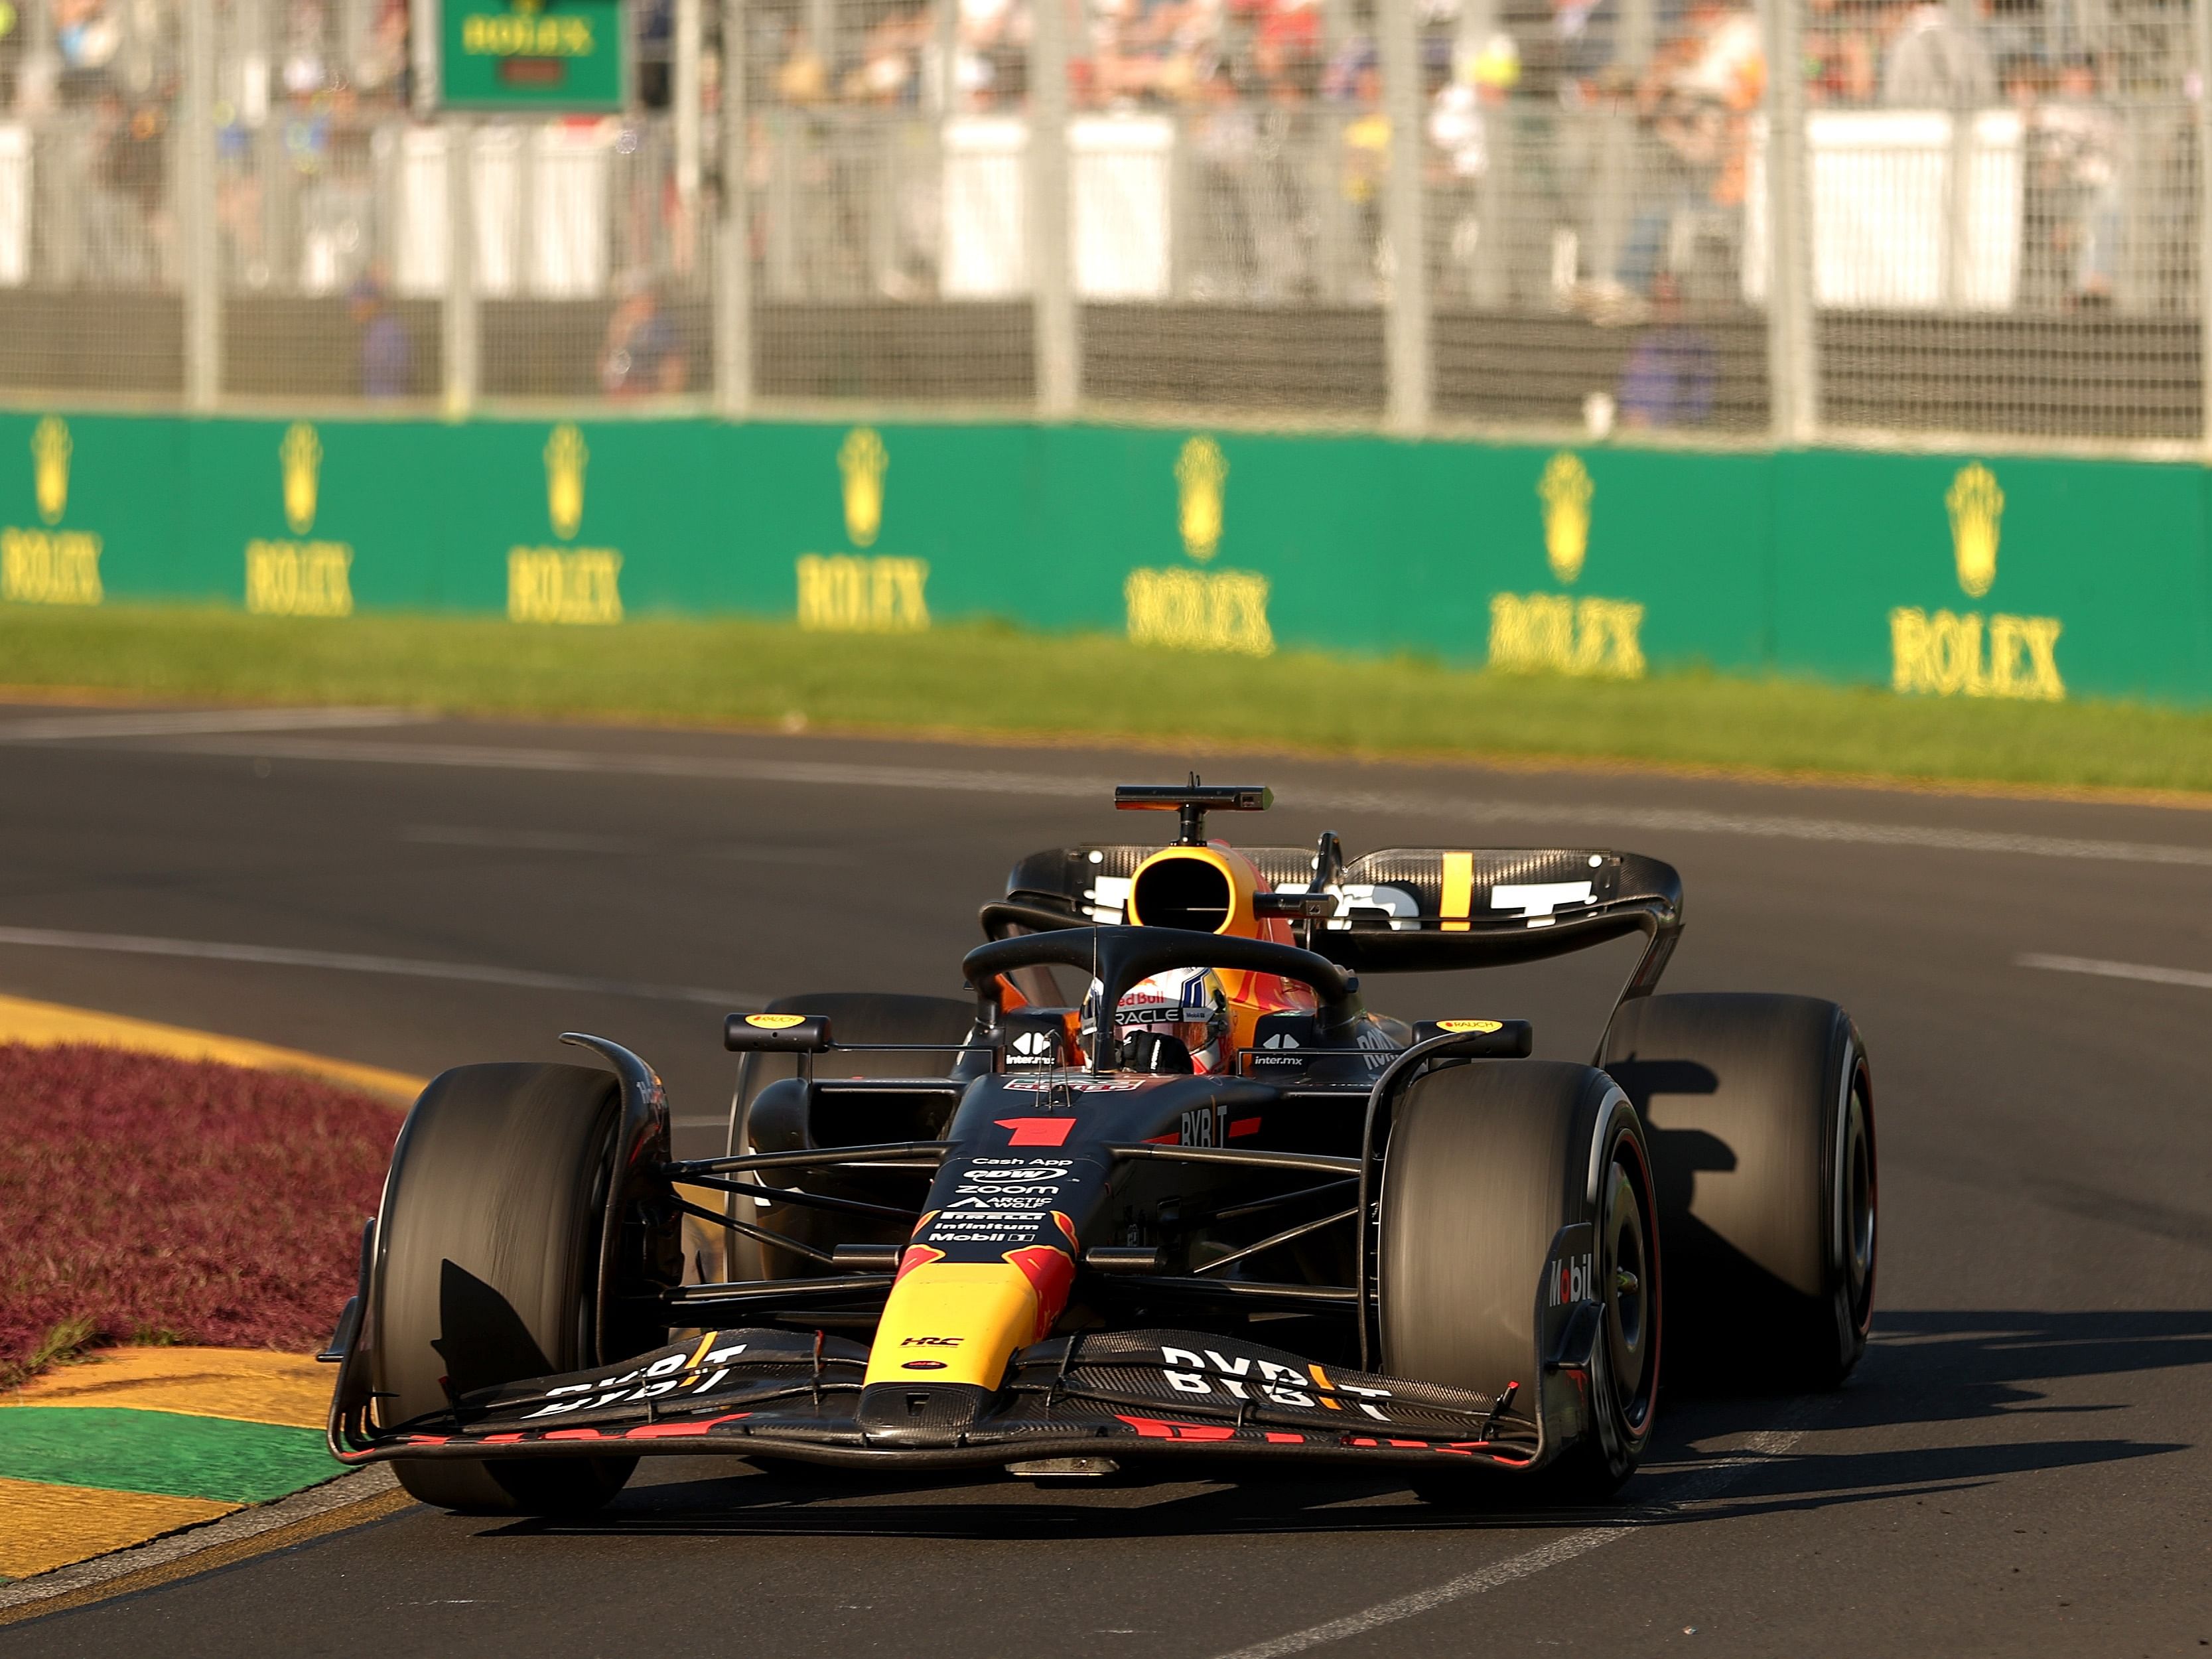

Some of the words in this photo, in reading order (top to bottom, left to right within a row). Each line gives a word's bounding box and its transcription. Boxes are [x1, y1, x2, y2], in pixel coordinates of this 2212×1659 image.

[1125, 567, 1276, 658] ROLEX
[1488, 593, 1646, 679] ROLEX
[1890, 607, 2065, 701] ROLEX
[1119, 993, 1135, 1007] ed
[1138, 991, 1164, 1004] Bull
[1115, 1009, 1179, 1025] RACLE
[1255, 1056, 1303, 1065] inter.mx
[994, 1118, 1077, 1147] 1
[955, 1185, 1059, 1194] zoom
[929, 1233, 1005, 1242] Mobil
[1550, 1253, 1592, 1307] Mobil
[900, 1337, 965, 1346] HRC
[1162, 1346, 1392, 1421] BYBIT
